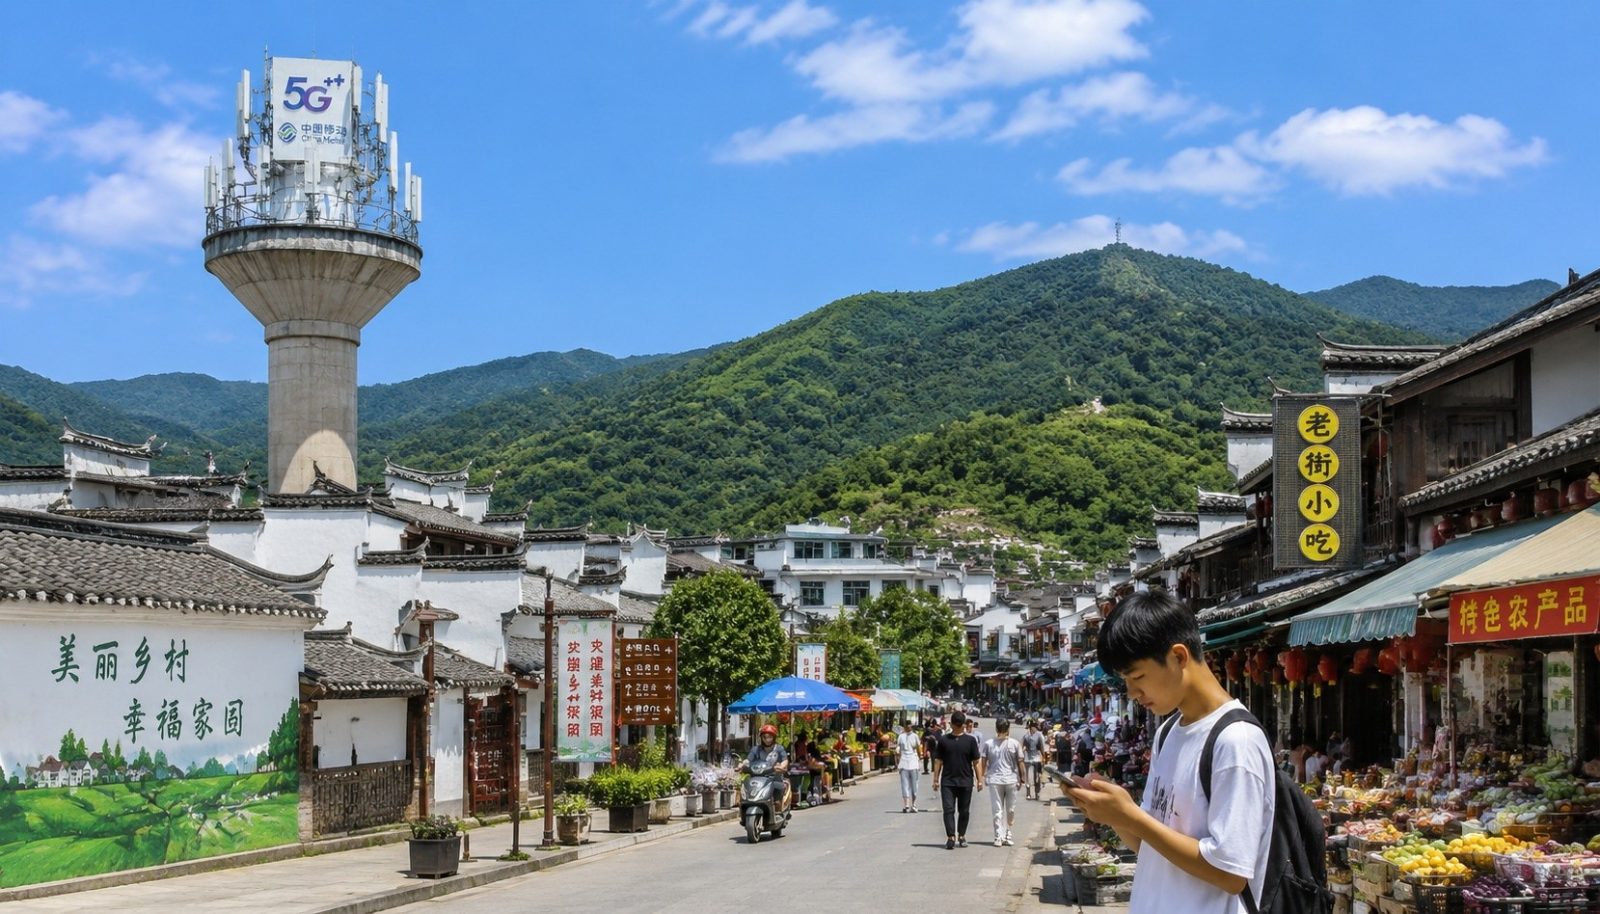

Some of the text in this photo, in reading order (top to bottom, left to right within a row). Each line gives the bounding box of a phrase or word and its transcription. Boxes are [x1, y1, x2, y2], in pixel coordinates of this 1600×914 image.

[1305, 411, 1333, 555] 老街小吃
[1459, 586, 1587, 635] 特色农产品
[51, 633, 189, 684] 美丽乡村
